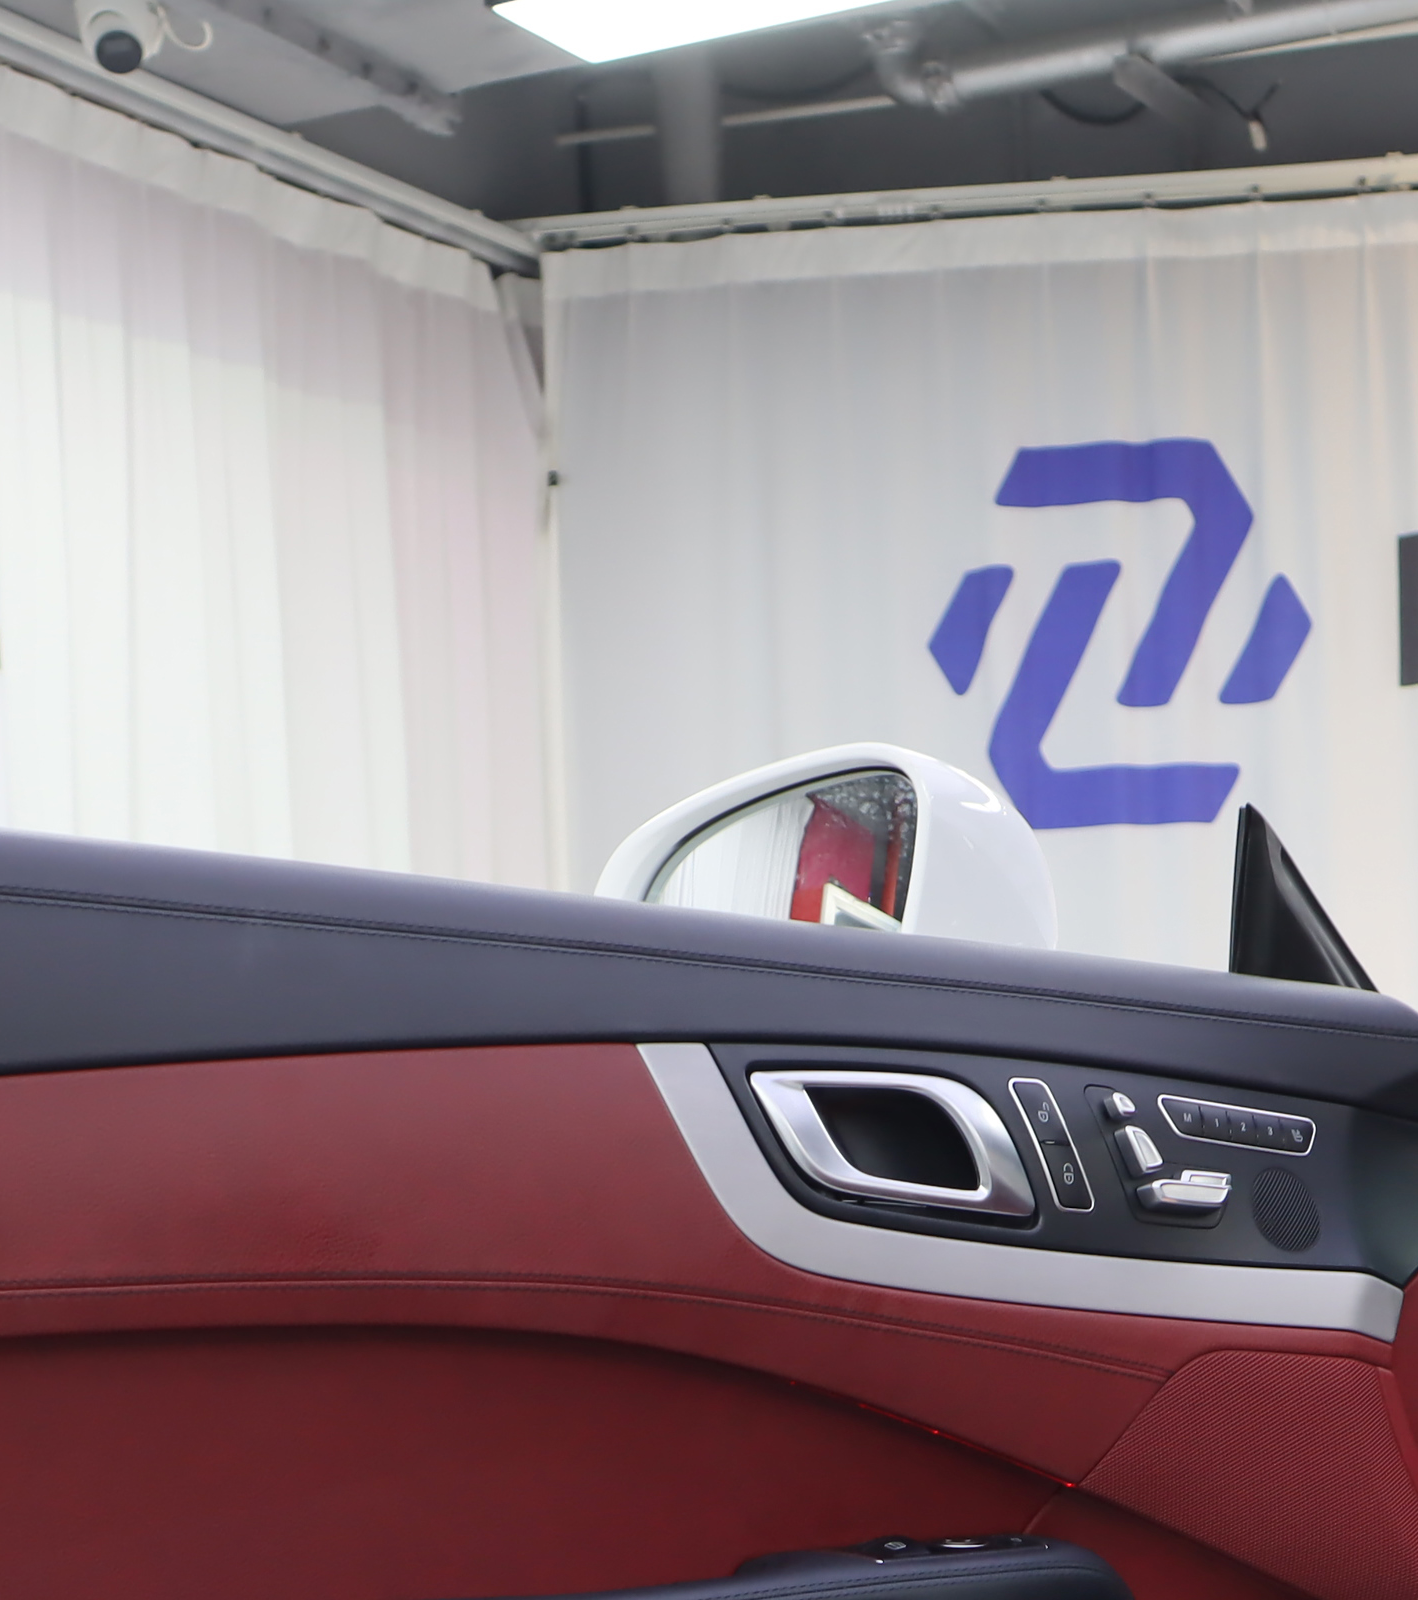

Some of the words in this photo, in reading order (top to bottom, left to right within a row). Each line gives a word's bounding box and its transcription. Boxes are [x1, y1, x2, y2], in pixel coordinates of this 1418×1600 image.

[1183, 1112, 1192, 1123] M
[1240, 1122, 1247, 1132] 2
[1267, 1126, 1274, 1136] 3
